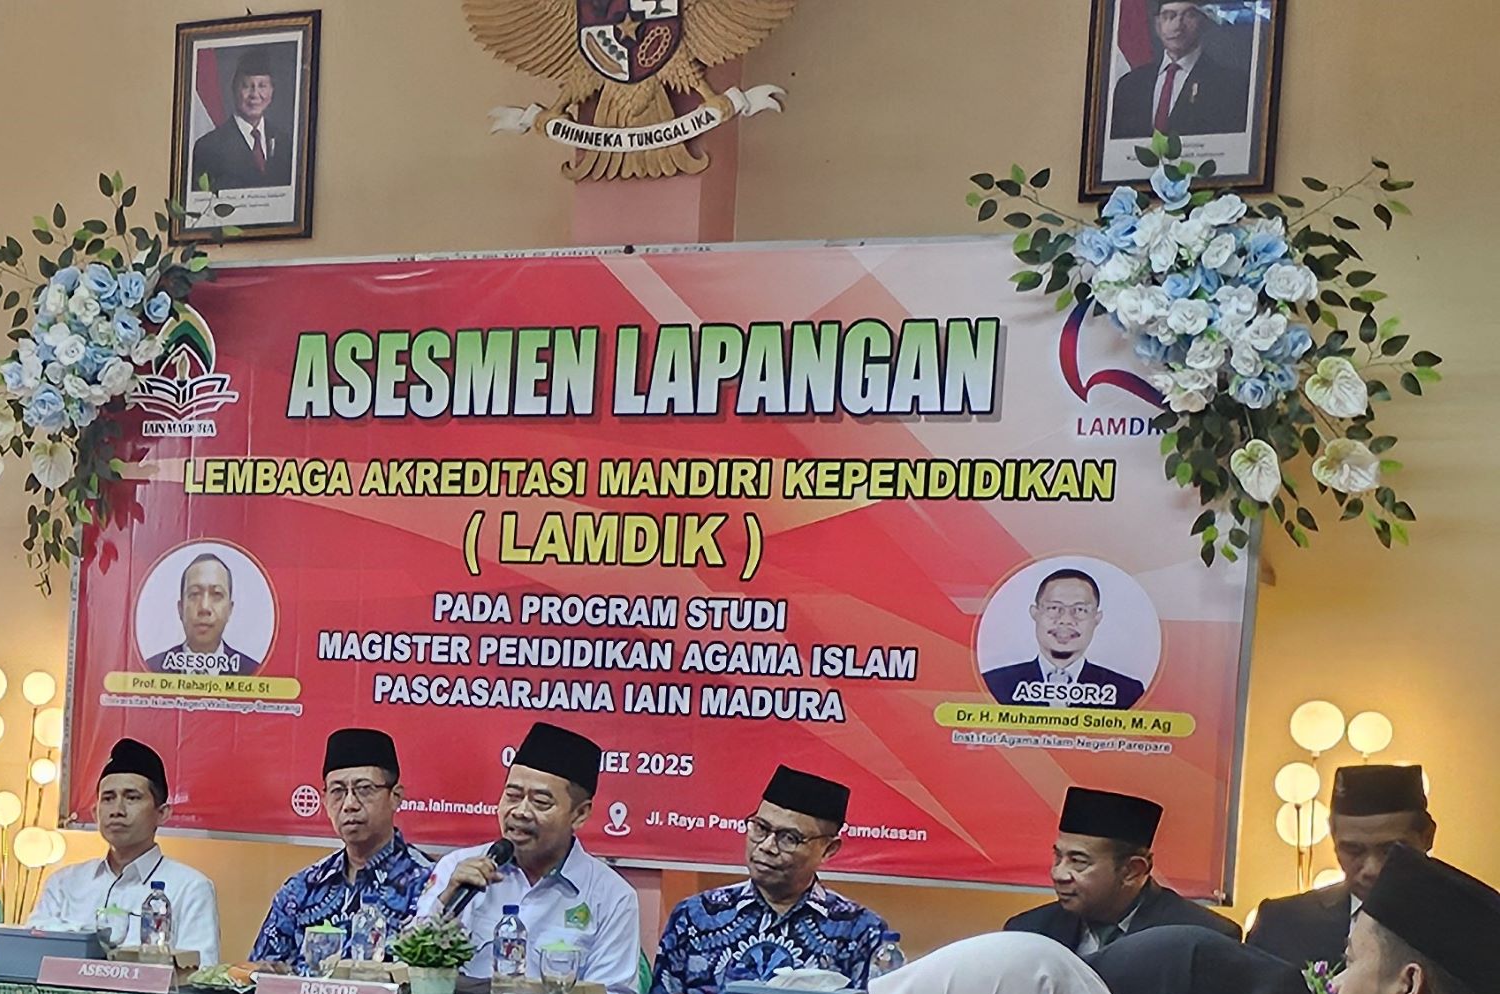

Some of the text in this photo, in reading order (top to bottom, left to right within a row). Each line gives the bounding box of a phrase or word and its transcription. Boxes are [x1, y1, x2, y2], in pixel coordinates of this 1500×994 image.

[551, 110, 716, 148] BHINNEKA TUNGGAL IKA
[287, 317, 1001, 419] ASESMEN LAPANGAN
[144, 423, 165, 434] IAIN
[184, 459, 1116, 501] LEMBAGA AKREDITASI MANDIRI KEPENDIDIKAN
[500, 511, 728, 568] LAMDIK
[434, 591, 788, 631] PADA PROGRAM STUDI
[165, 654, 240, 670] ASESOR 1
[318, 631, 918, 681] MAGISTER PENDIDIKAN AGAMA ISLAM
[133, 678, 157, 690] Prof.
[160, 679, 175, 690] Dr.
[226, 682, 255, 693] M.Ed.
[258, 682, 270, 693] St
[1015, 685, 1115, 703] ASESOR 2
[374, 674, 846, 723] PASCASARJANA IAIN MADURA
[957, 710, 1172, 733] Dr. H. Muhammad Saleh, M. Ag
[954, 732, 1171, 753] Institut Agama Islam Negeri Parepare
[599, 752, 630, 773] EI
[636, 752, 694, 776] 2025
[646, 812, 663, 826] Jl.
[668, 813, 704, 831] Raya
[709, 815, 747, 834] Pang
[78, 963, 130, 980] ASESOR
